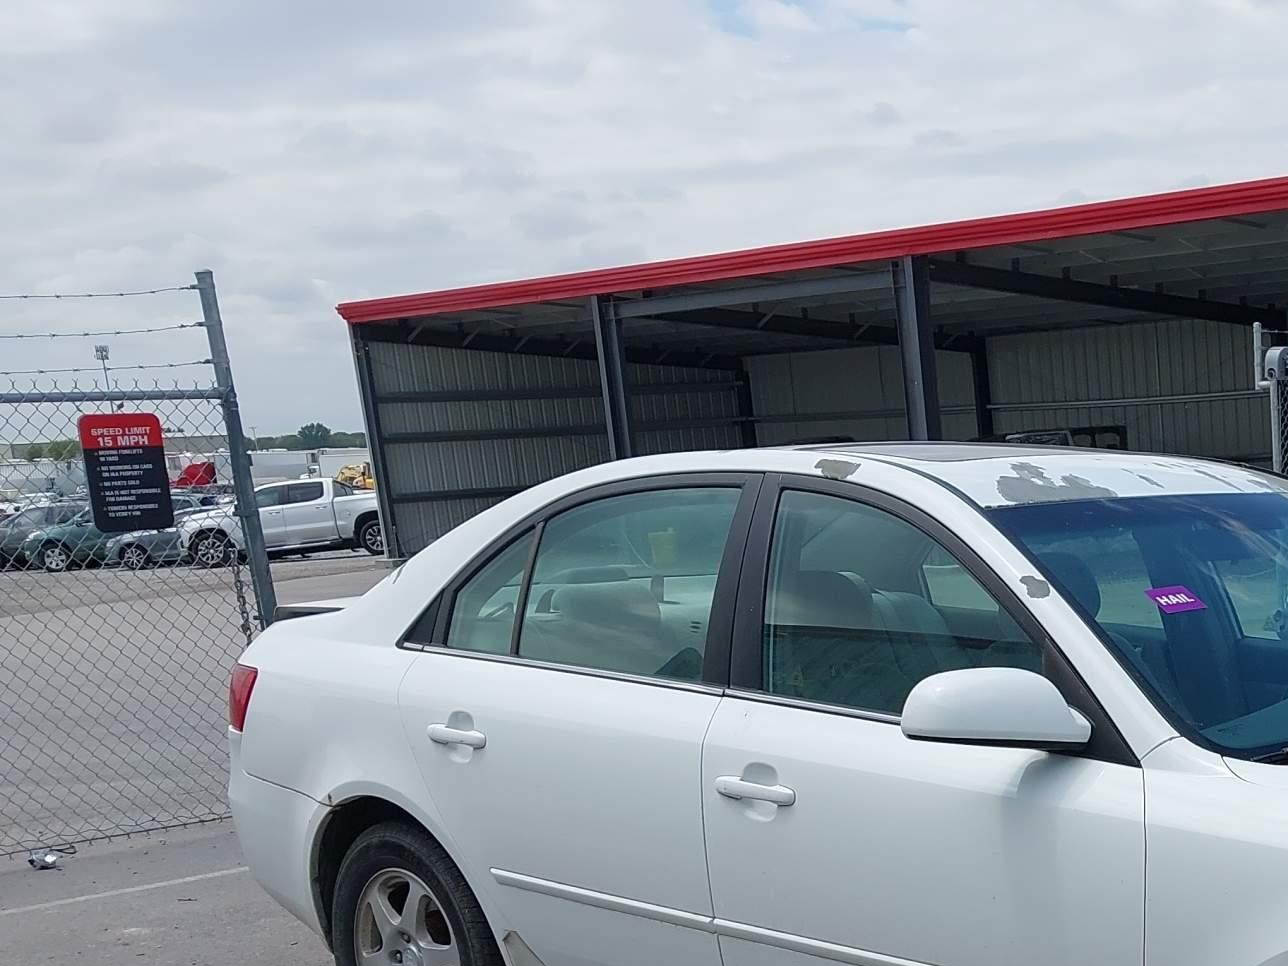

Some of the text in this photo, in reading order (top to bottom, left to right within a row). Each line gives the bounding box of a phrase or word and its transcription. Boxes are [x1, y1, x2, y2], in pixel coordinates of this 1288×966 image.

[91, 426, 151, 436] SPEED LIMIT
[97, 435, 148, 446] 15 MPH
[1156, 593, 1195, 606] HAIL
